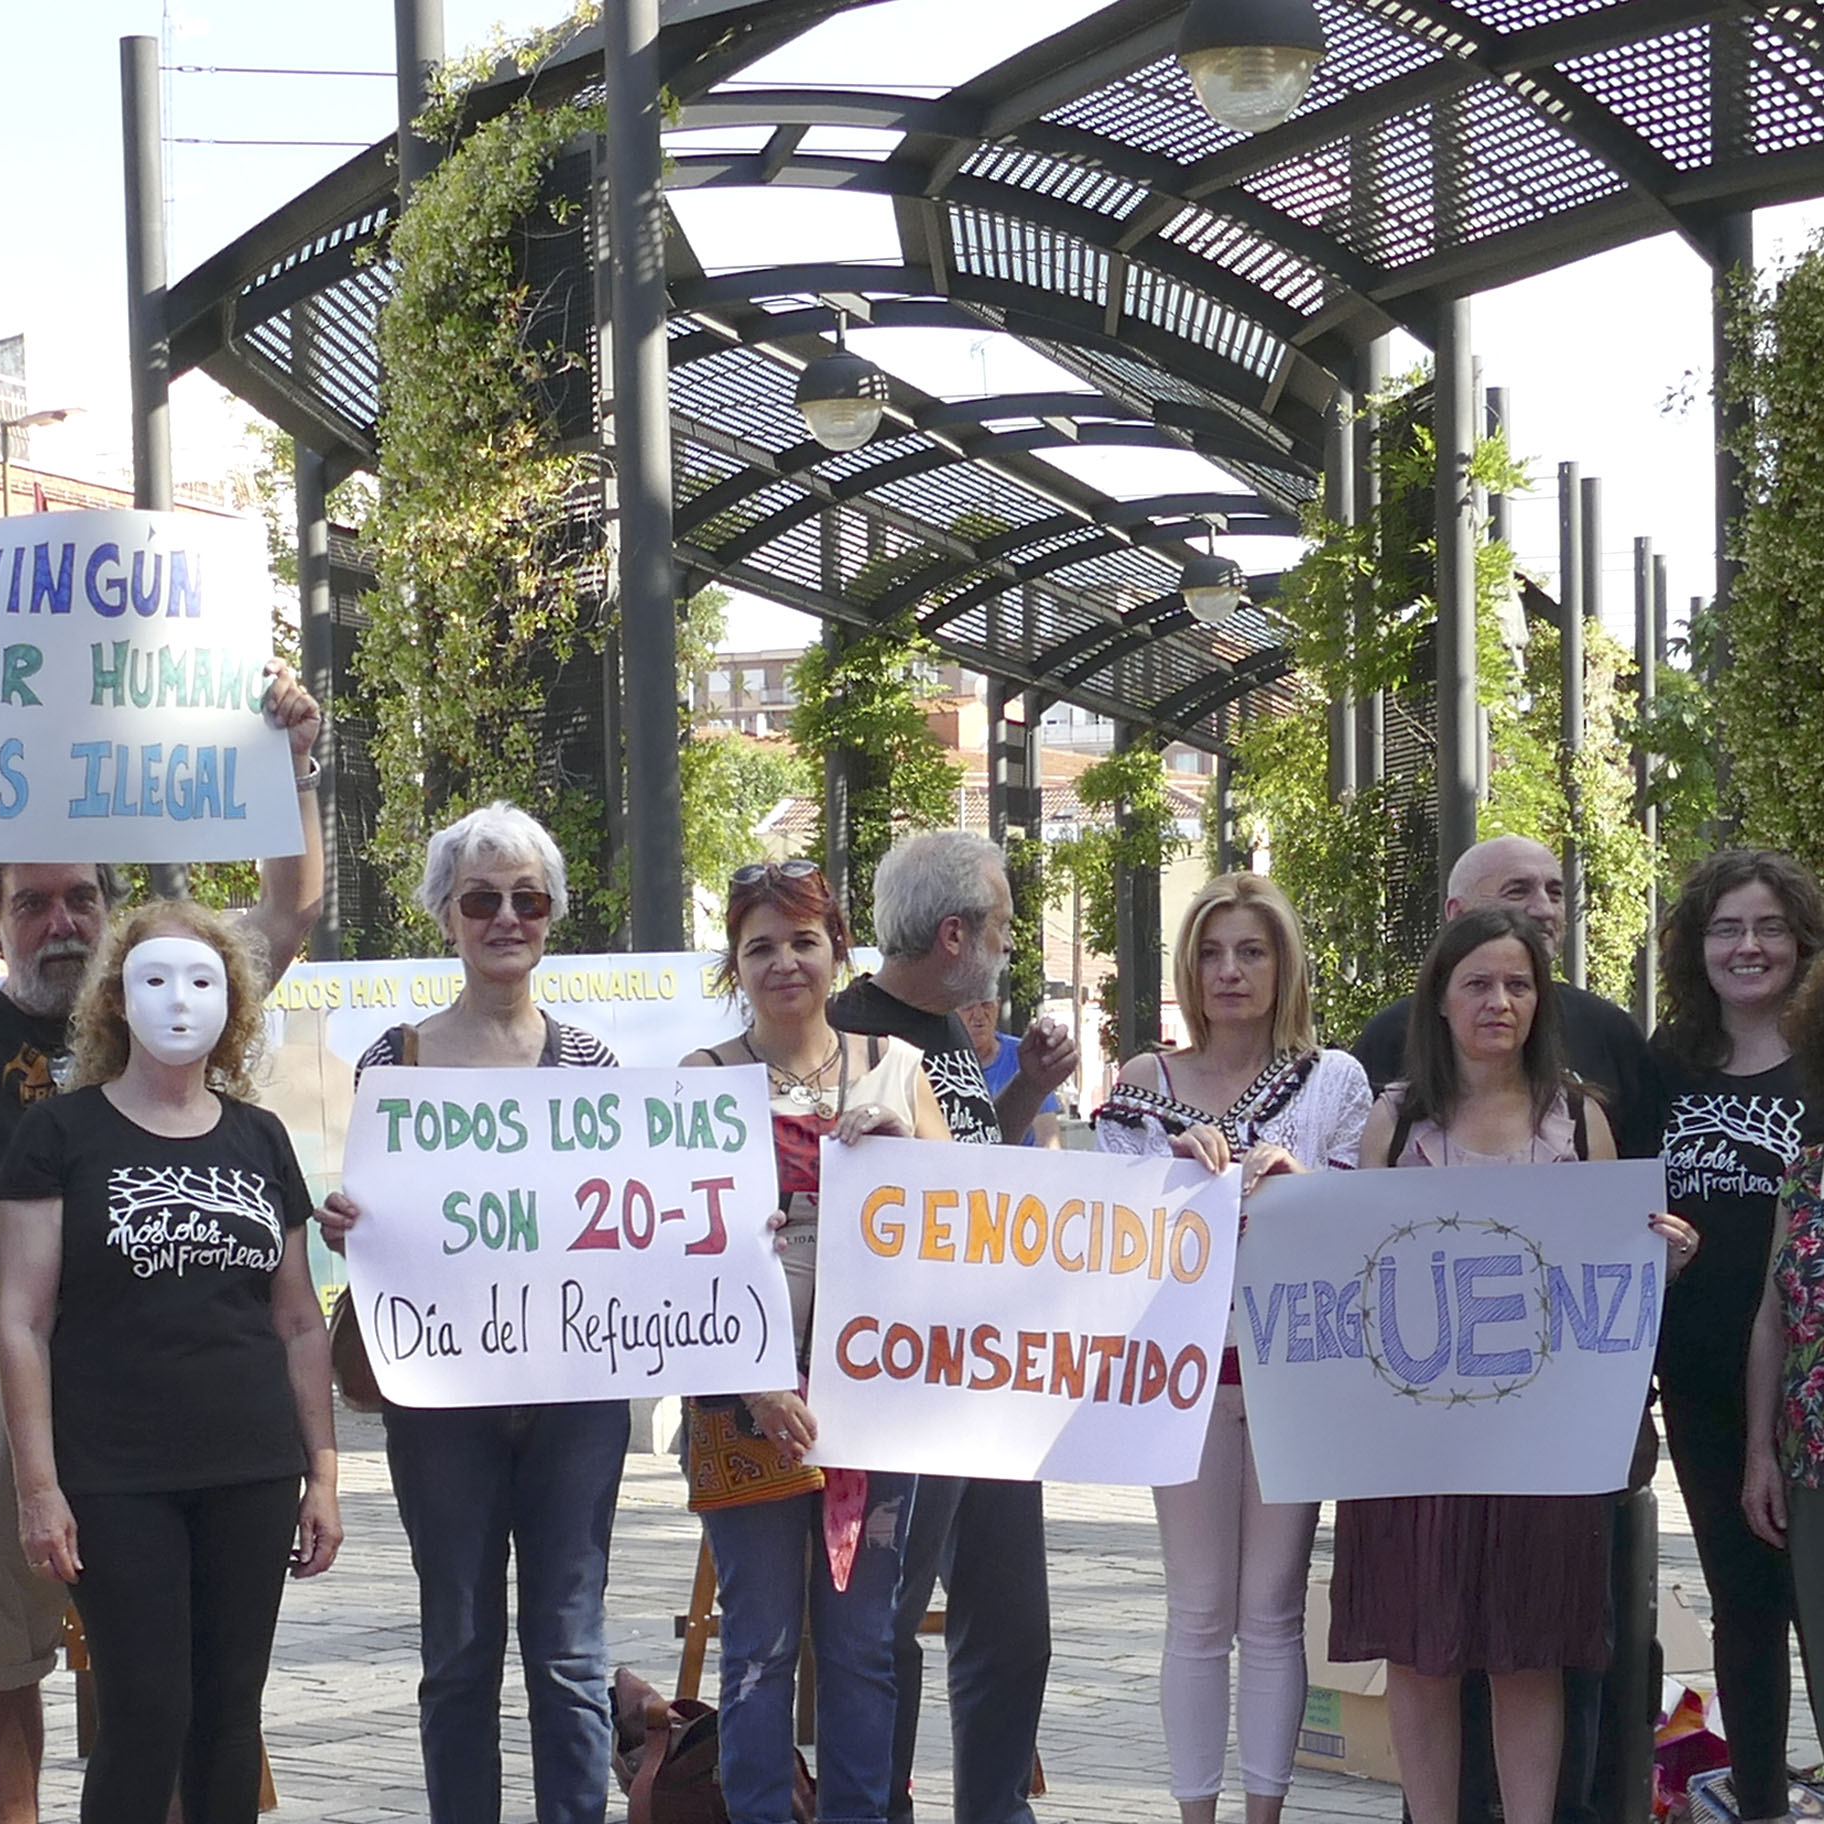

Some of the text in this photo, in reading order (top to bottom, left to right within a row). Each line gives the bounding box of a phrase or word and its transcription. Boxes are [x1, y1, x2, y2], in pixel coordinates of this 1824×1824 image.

[68, 740, 246, 821] ILEGAL
[262, 976, 342, 1010] ADOS
[350, 977, 404, 1008] HAY
[376, 1098, 528, 1154] TODOS
[549, 1093, 622, 1153] LOS
[645, 1080, 748, 1153] DÍAS
[442, 1176, 735, 1257] SON 20-J
[860, 1185, 1211, 1284] GENOCIDIO
[373, 1291, 462, 1365] (Día
[481, 1284, 529, 1355] del
[560, 1277, 769, 1377] Refugiado)
[835, 1315, 1208, 1410] CONSENTIDO
